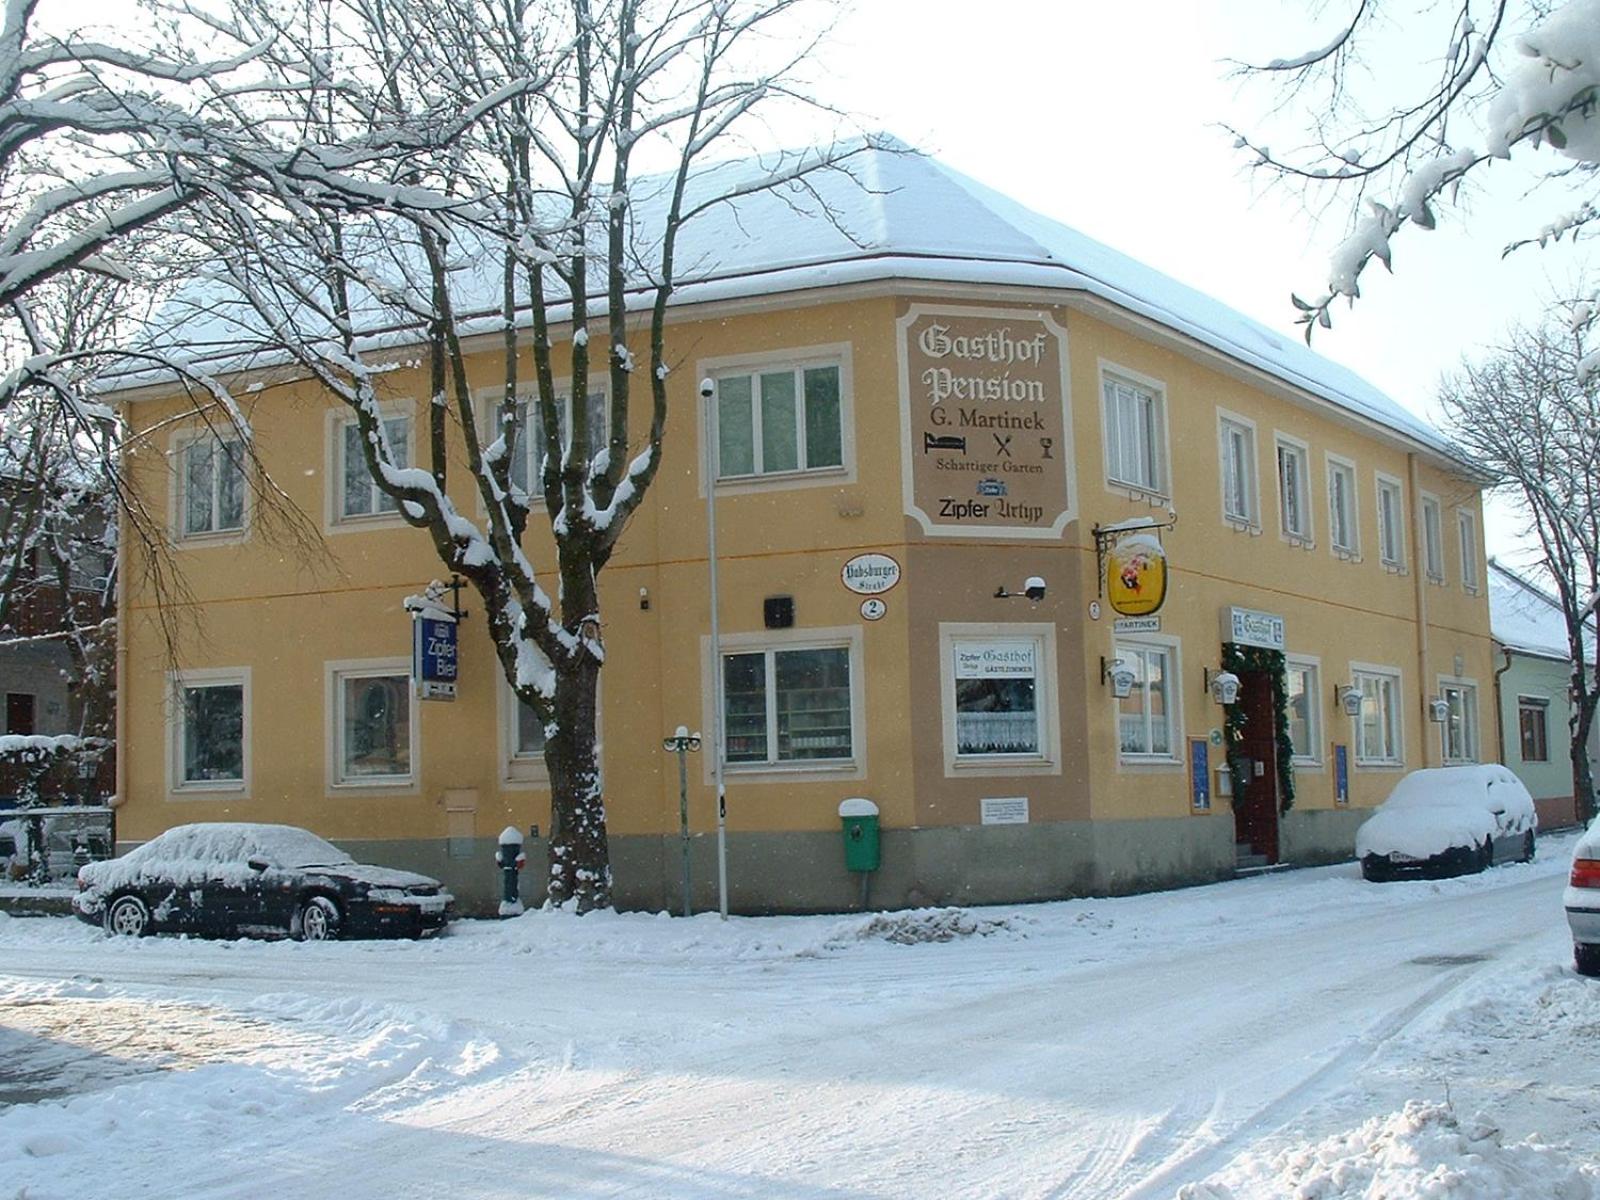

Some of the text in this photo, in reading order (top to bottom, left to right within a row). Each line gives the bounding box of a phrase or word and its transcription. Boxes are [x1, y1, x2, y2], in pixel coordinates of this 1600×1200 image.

[919, 323, 1047, 367] Gasthof
[921, 367, 1045, 405] Pension
[930, 408, 1045, 430] G. Martinek
[936, 458, 1044, 474] Schattiger Garten
[939, 498, 1043, 523] Zipfer Urtyp
[869, 601, 877, 613] 2
[983, 649, 1032, 663] Gasthof
